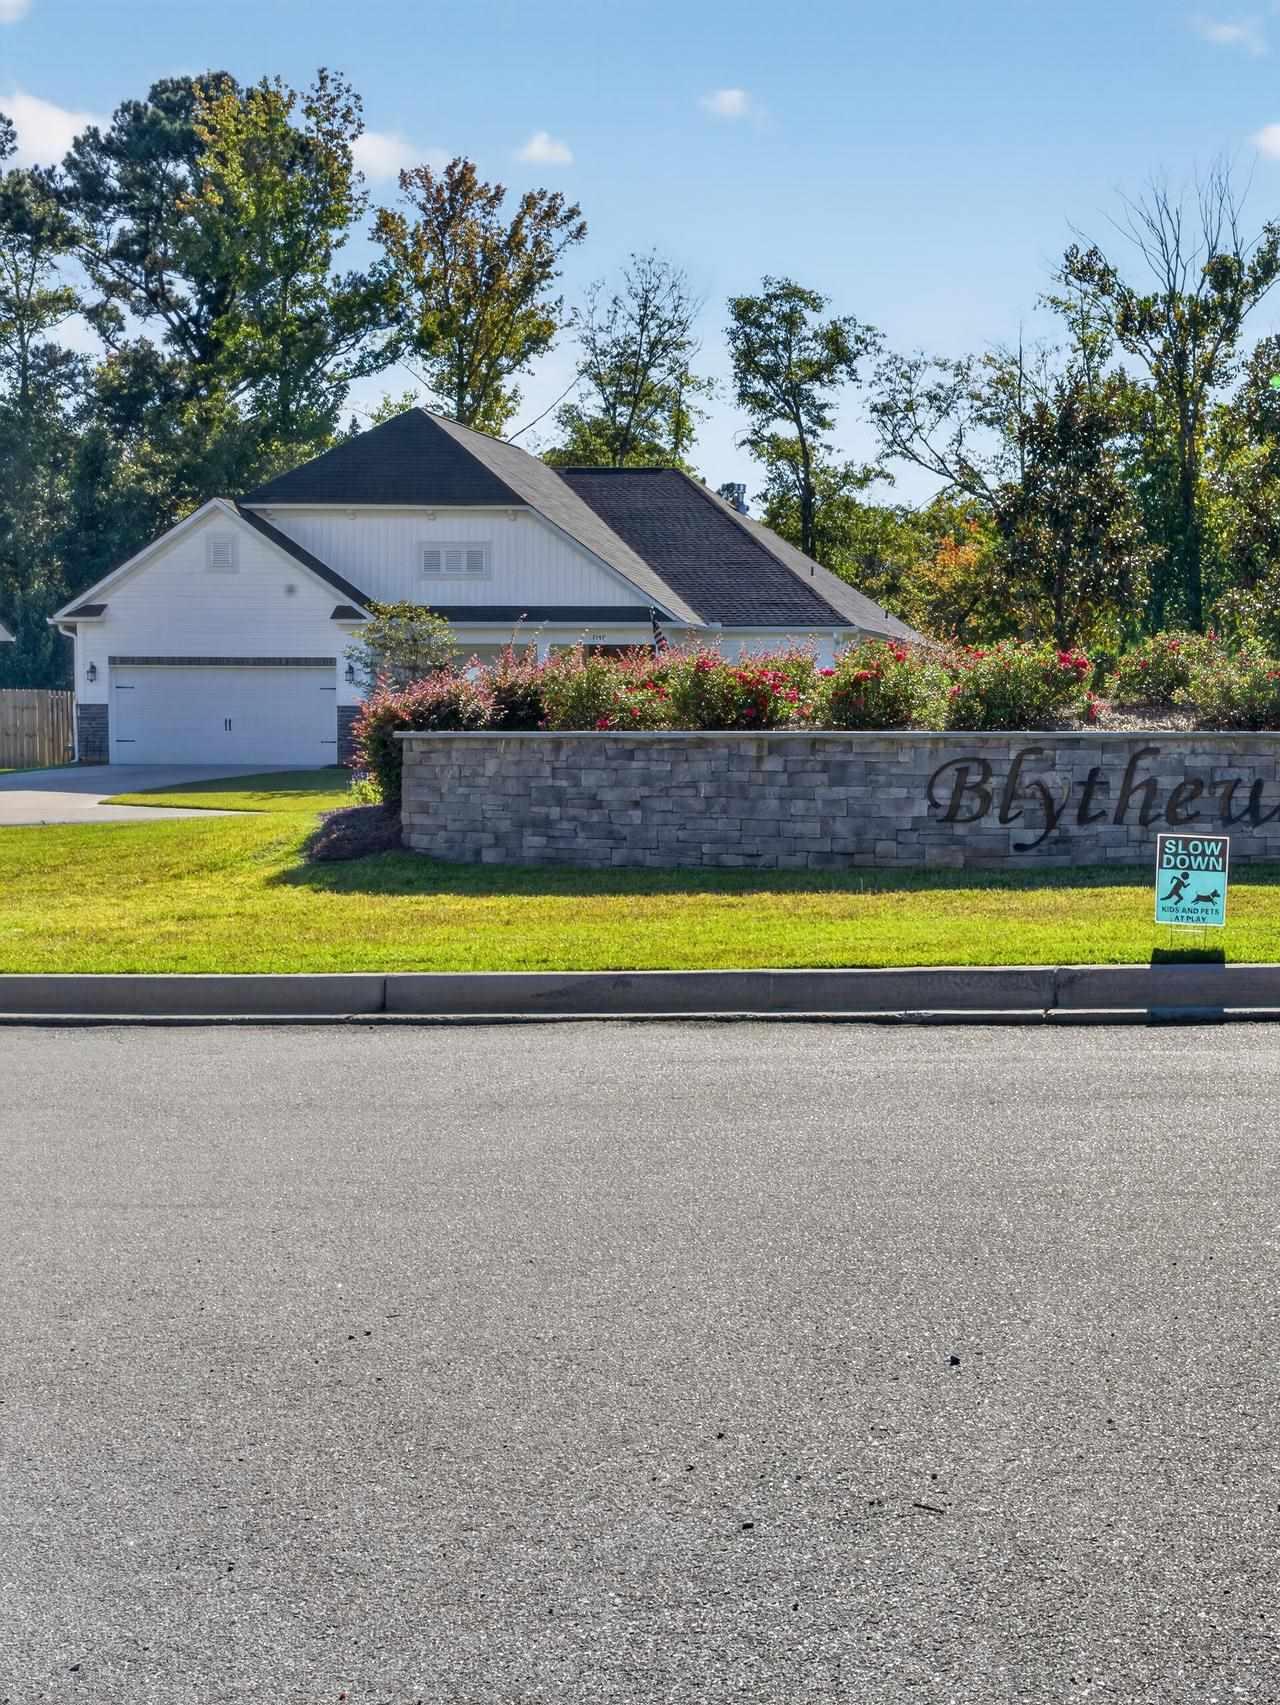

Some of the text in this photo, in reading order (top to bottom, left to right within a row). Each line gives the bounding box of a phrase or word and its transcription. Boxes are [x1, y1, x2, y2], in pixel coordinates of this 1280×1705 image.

[1164, 839, 1222, 856] SLOW
[1162, 854, 1223, 871] DOWN
[1161, 905, 1220, 916] KIDS AND PETS
[1186, 915, 1207, 923] PLAY
